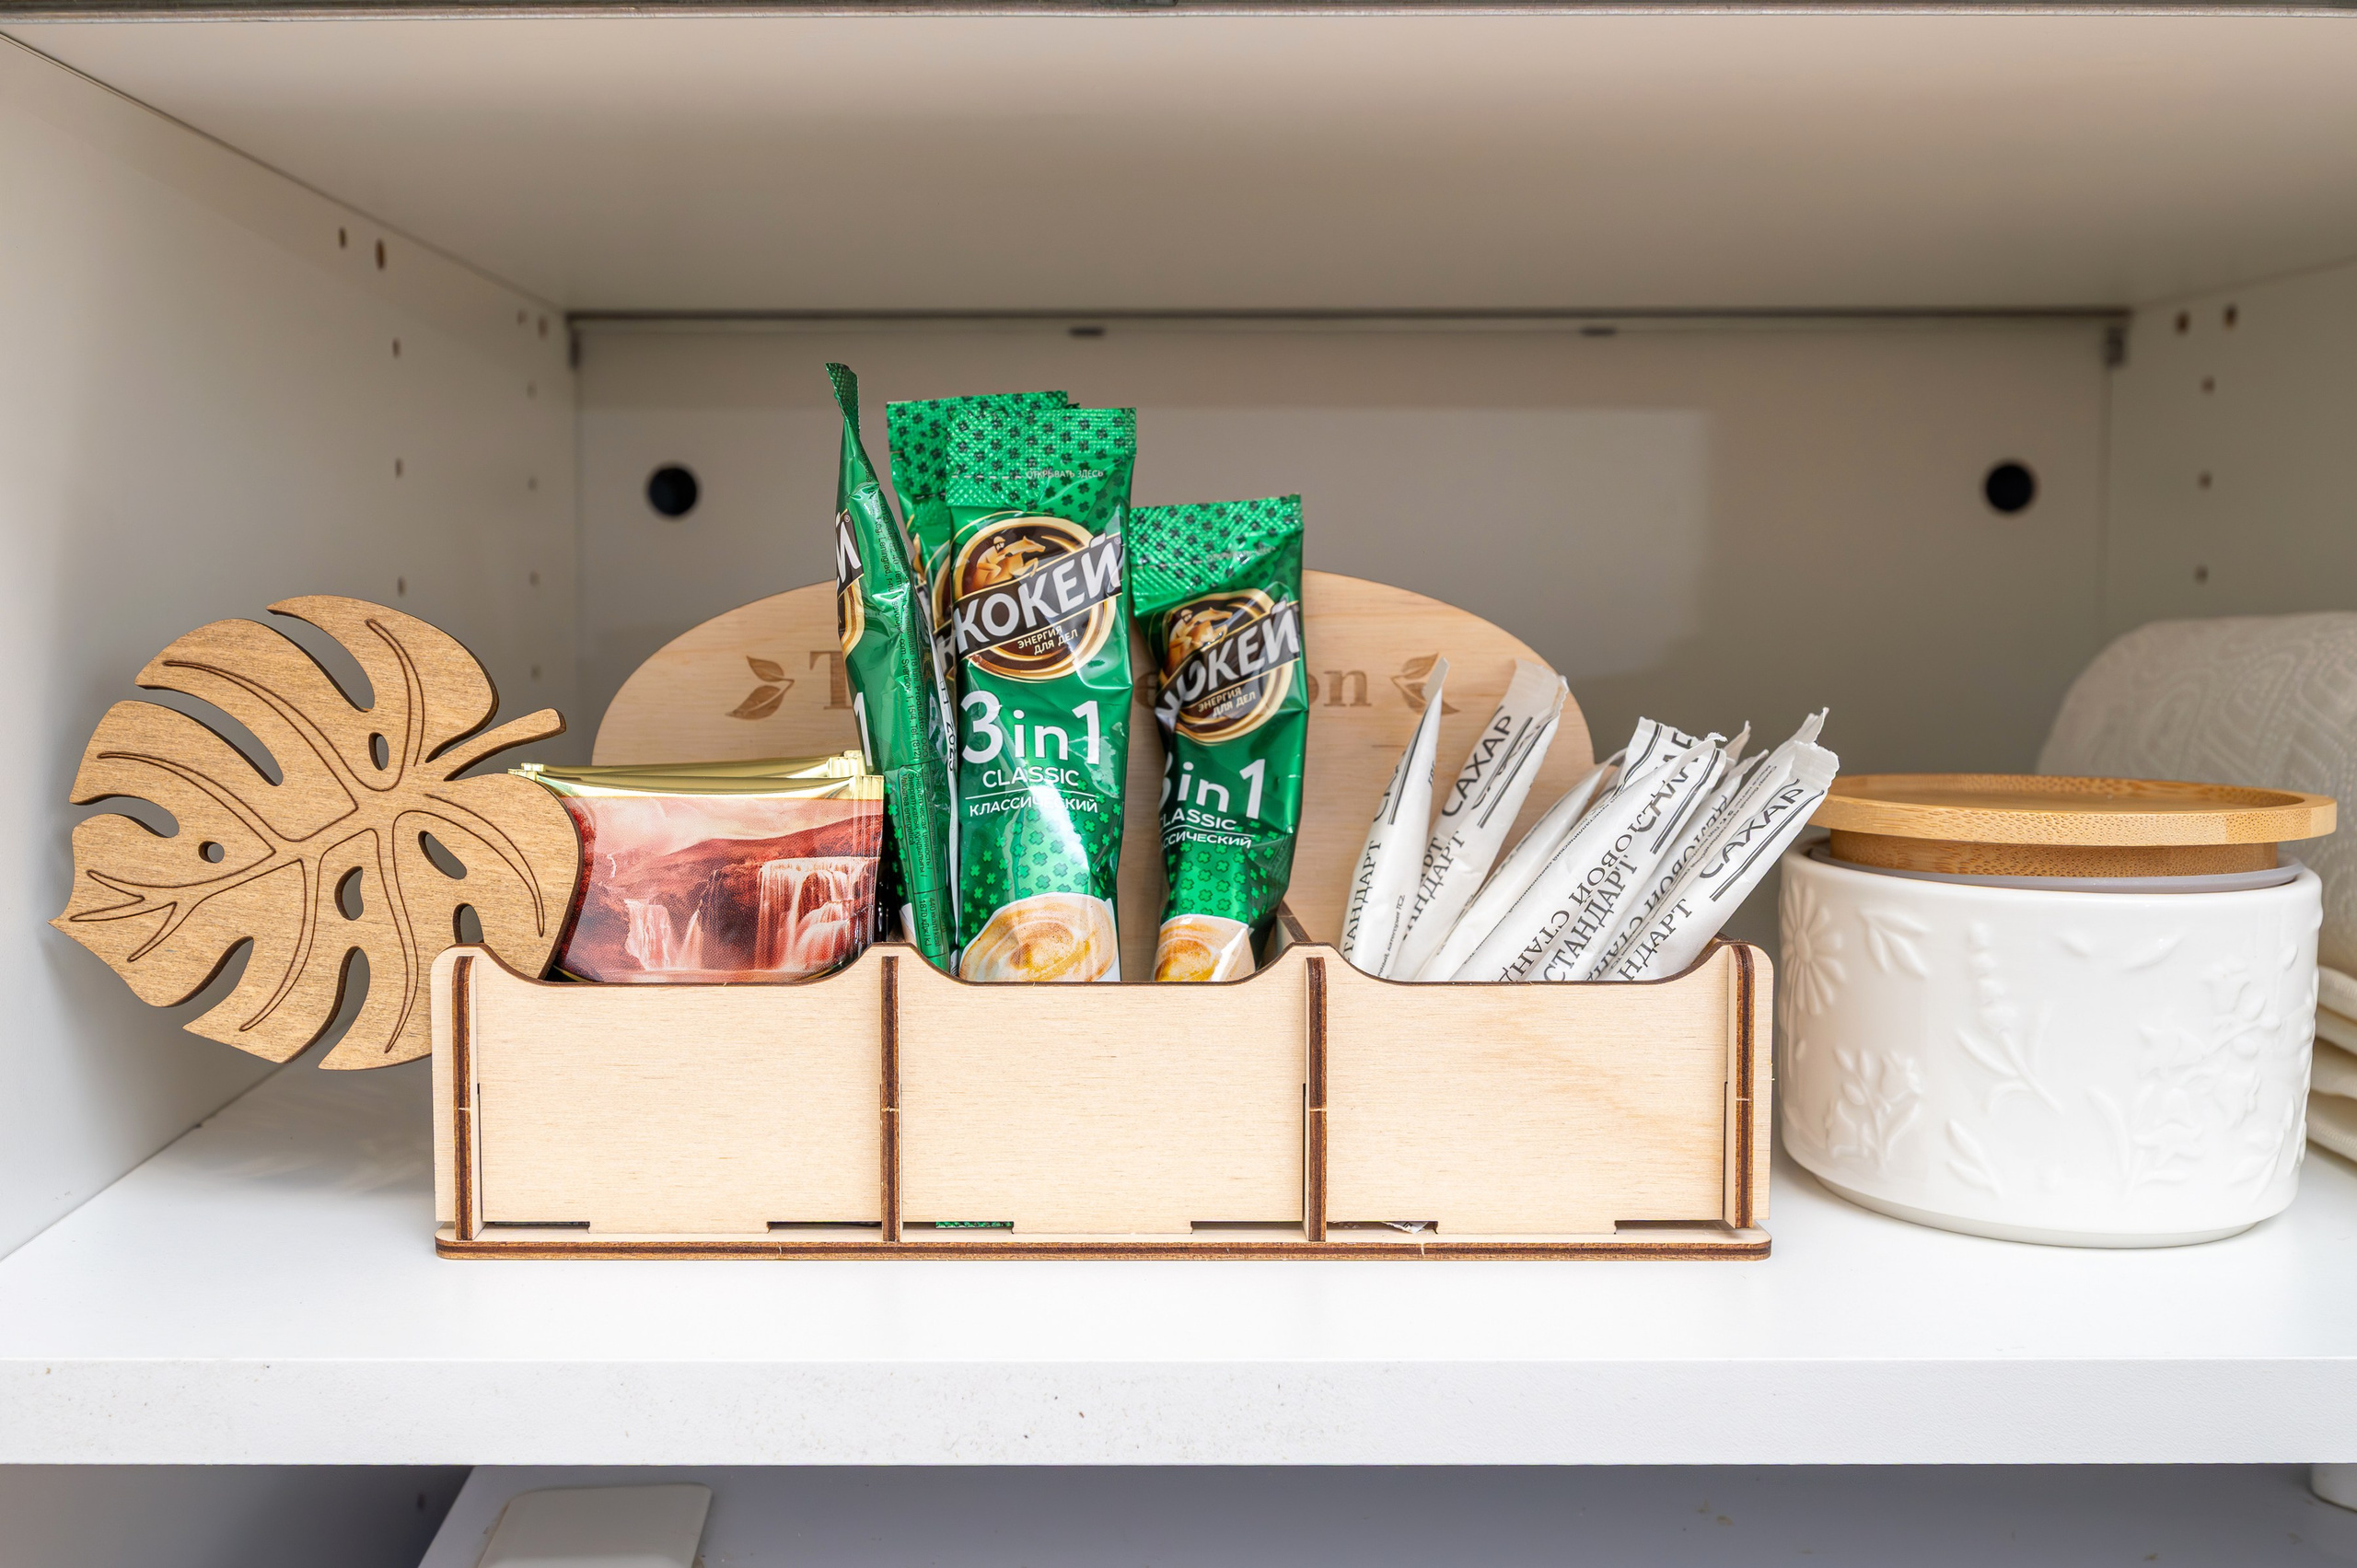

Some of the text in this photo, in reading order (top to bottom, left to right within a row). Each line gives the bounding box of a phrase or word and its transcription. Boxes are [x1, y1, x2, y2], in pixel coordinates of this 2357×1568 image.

[1027, 470, 1104, 479] ОТКРЫВАТЬ ЗДЕСЬ
[877, 537, 891, 576] Leningrad,
[1017, 625, 1063, 649] ЭНЕРГИЯ
[1033, 629, 1078, 656] ДЛЯ ДЕЛ
[1198, 687, 1242, 713] ЭНЕРГИЯ
[1212, 691, 1256, 718] ДЛЯ ДЕЛ
[982, 766, 1080, 788] CLASSIC
[1442, 715, 1513, 818] САХАР
[1160, 807, 1237, 830] LASSIC
[1161, 830, 1252, 849] ССИЧЕСКИЙ
[1700, 788, 1805, 878] САХАР
[919, 900, 927, 918] 1870
[1343, 840, 1382, 962] ТАНДАРТ
[1617, 898, 1692, 981] НДАРТ
